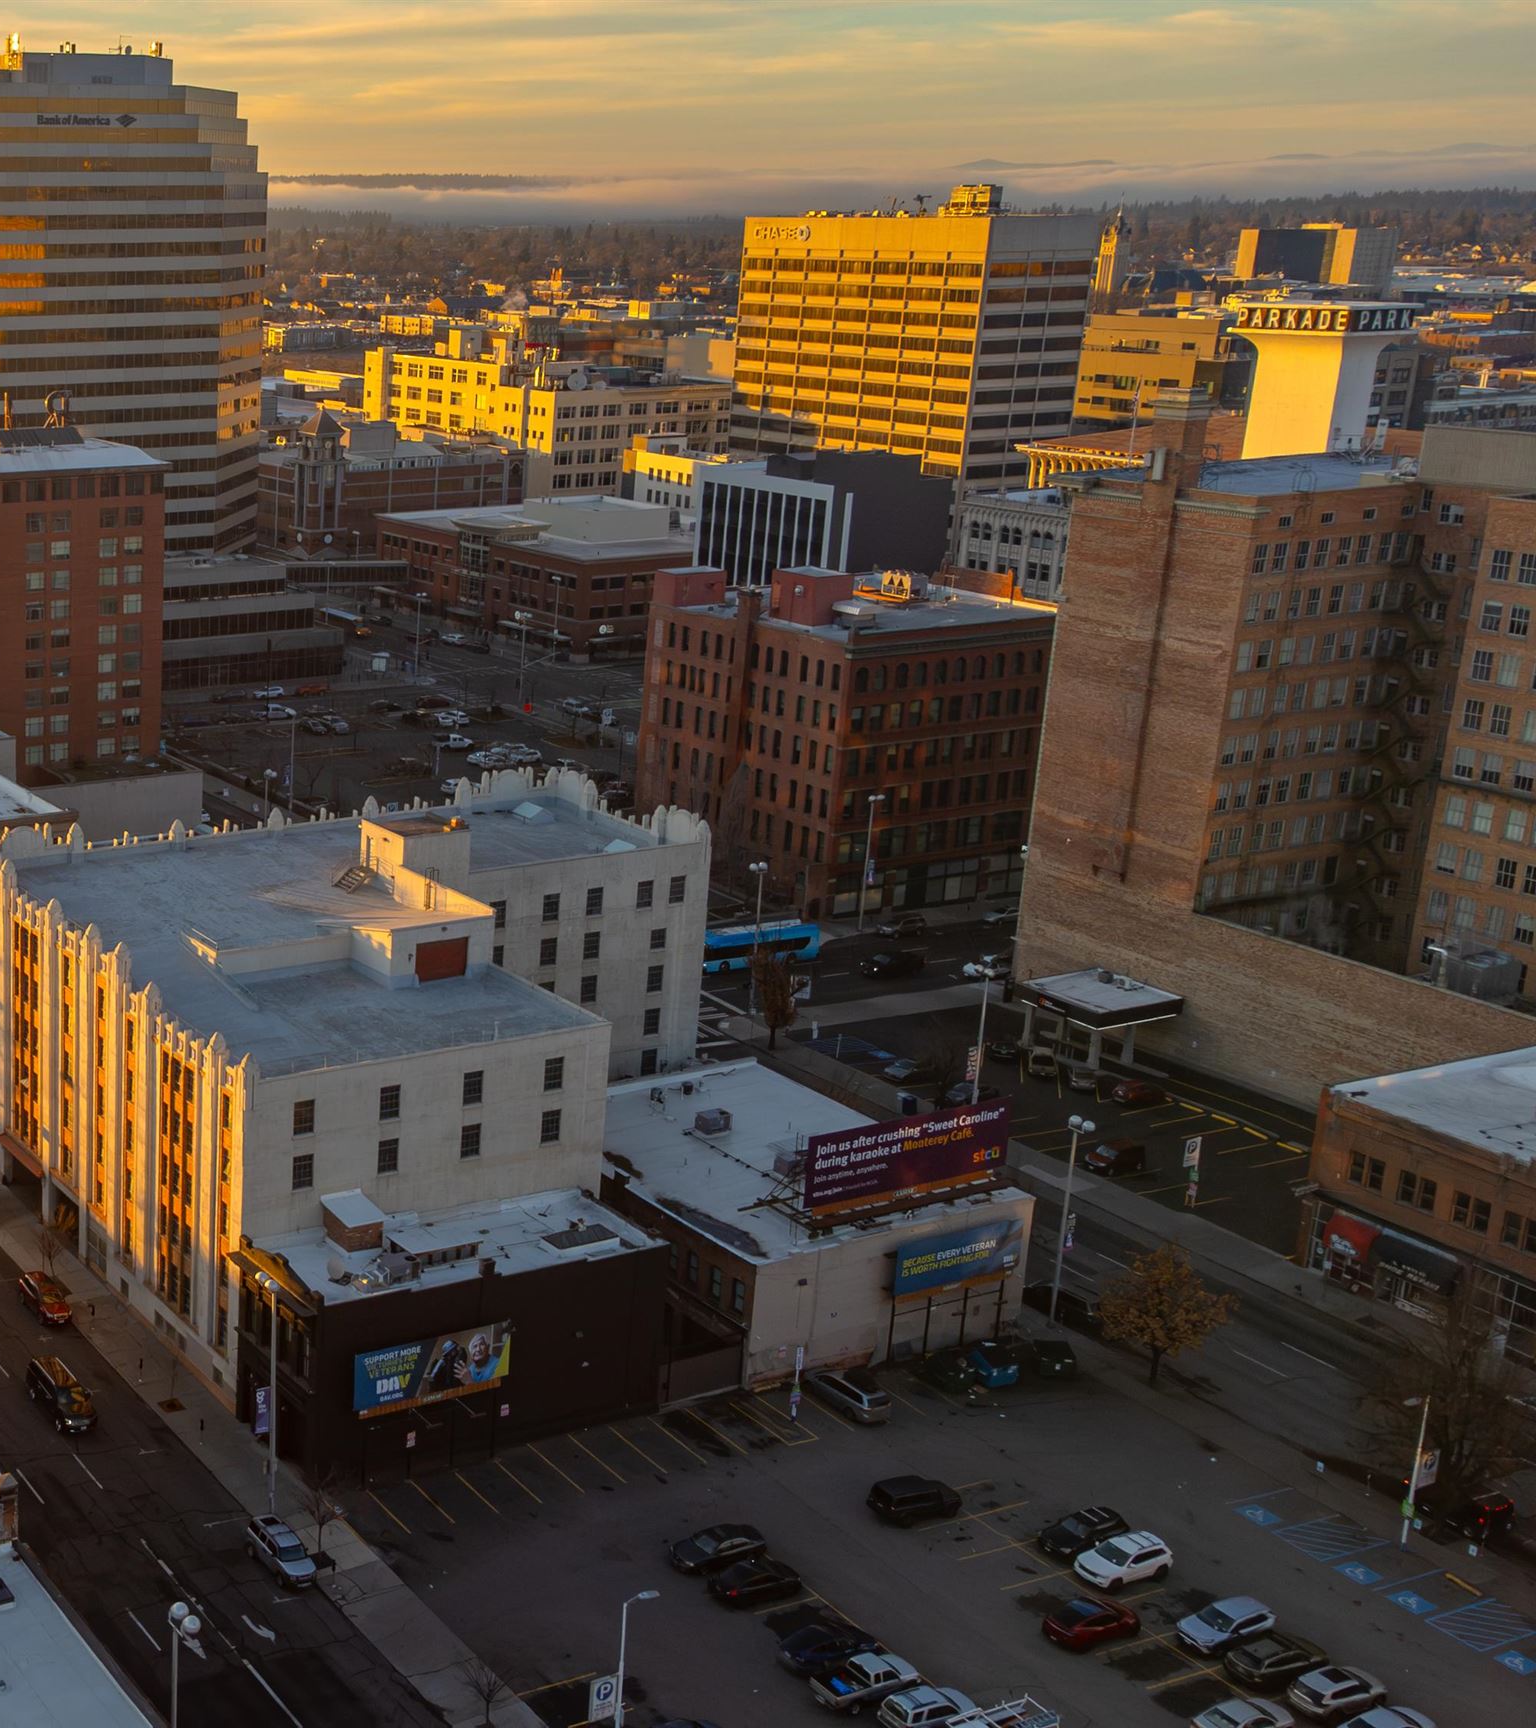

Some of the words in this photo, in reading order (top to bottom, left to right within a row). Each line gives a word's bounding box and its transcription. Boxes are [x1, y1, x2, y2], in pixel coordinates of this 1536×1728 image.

[37, 114, 61, 125] Bank
[61, 114, 71, 125] of
[72, 114, 110, 126] America
[753, 225, 798, 241] CHASE
[1237, 306, 1348, 331] PARKADE
[1358, 308, 1412, 330] PARK
[815, 1153, 848, 1171] during
[850, 1145, 889, 1163] karaoke
[890, 1143, 902, 1155] at
[902, 1133, 950, 1152] Monterey
[950, 1127, 974, 1142] Café.
[816, 1142, 837, 1158] Join
[838, 1139, 851, 1152] us
[852, 1135, 877, 1150] after
[877, 1125, 921, 1143] crushing
[903, 1253, 937, 1268] BECAUSE
[937, 1247, 962, 1260] EVERY
[962, 1239, 997, 1255] VETERAN
[902, 1268, 910, 1278] IS
[910, 1262, 939, 1276] WORTH
[939, 1254, 974, 1270] FIGHTING
[364, 1351, 399, 1366] SUPPORT
[400, 1345, 422, 1357] MORE
[369, 1361, 415, 1379] VETERANS
[376, 1373, 411, 1395] DAV
[599, 1683, 612, 1700] P
